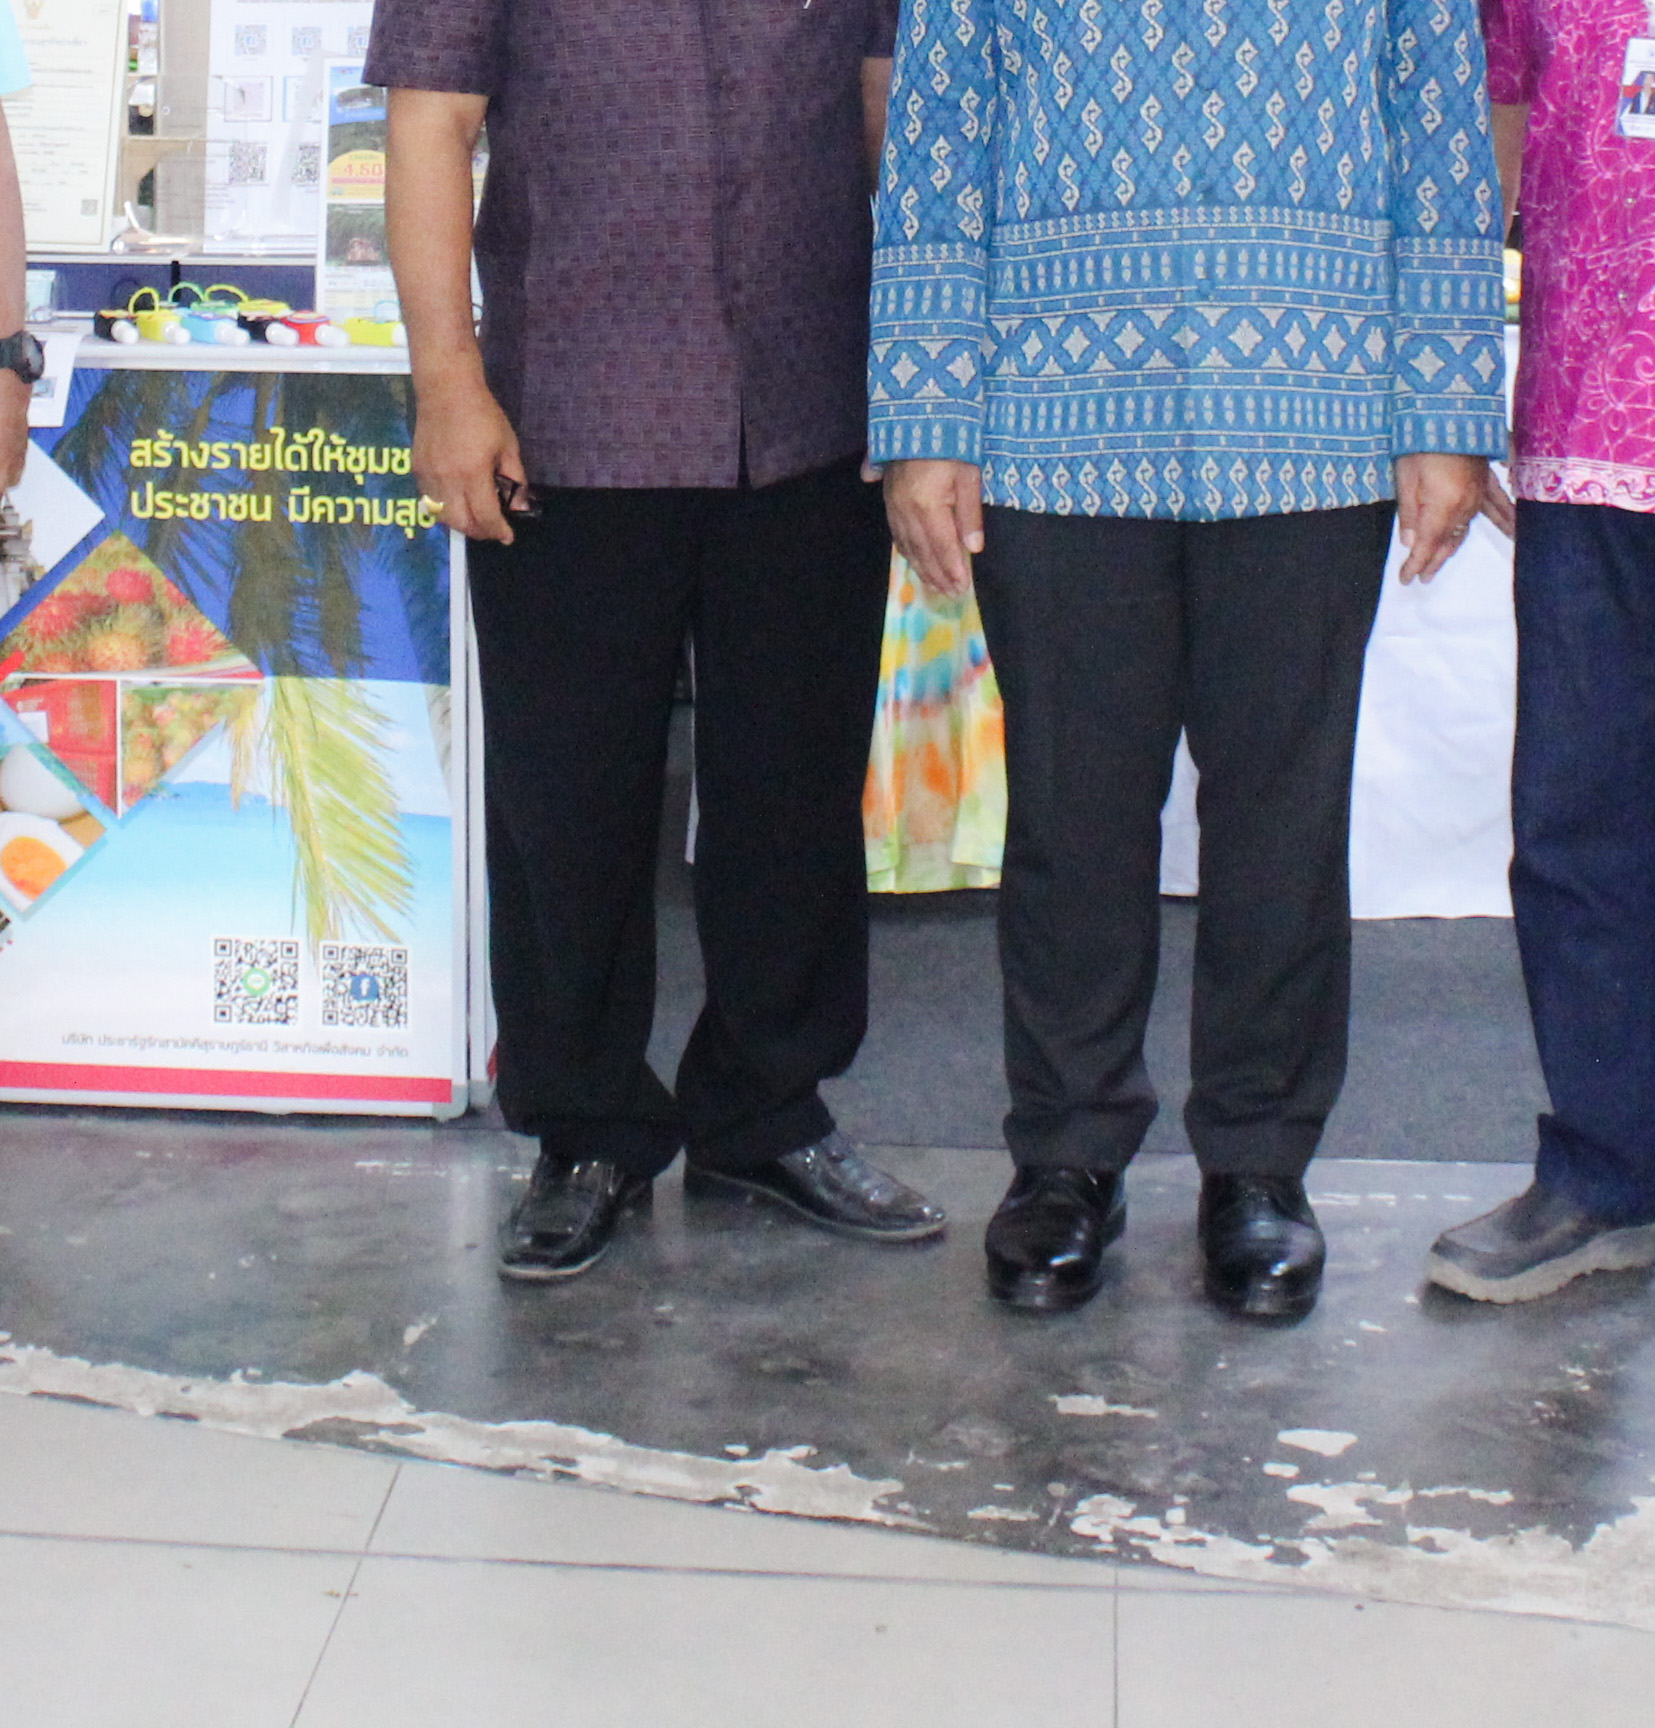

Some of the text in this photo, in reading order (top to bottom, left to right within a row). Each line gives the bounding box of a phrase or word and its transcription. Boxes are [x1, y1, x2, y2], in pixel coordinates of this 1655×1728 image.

[130, 426, 412, 484] สร้างรายได้ให้ชุมช
[131, 482, 272, 522] ประชาชน
